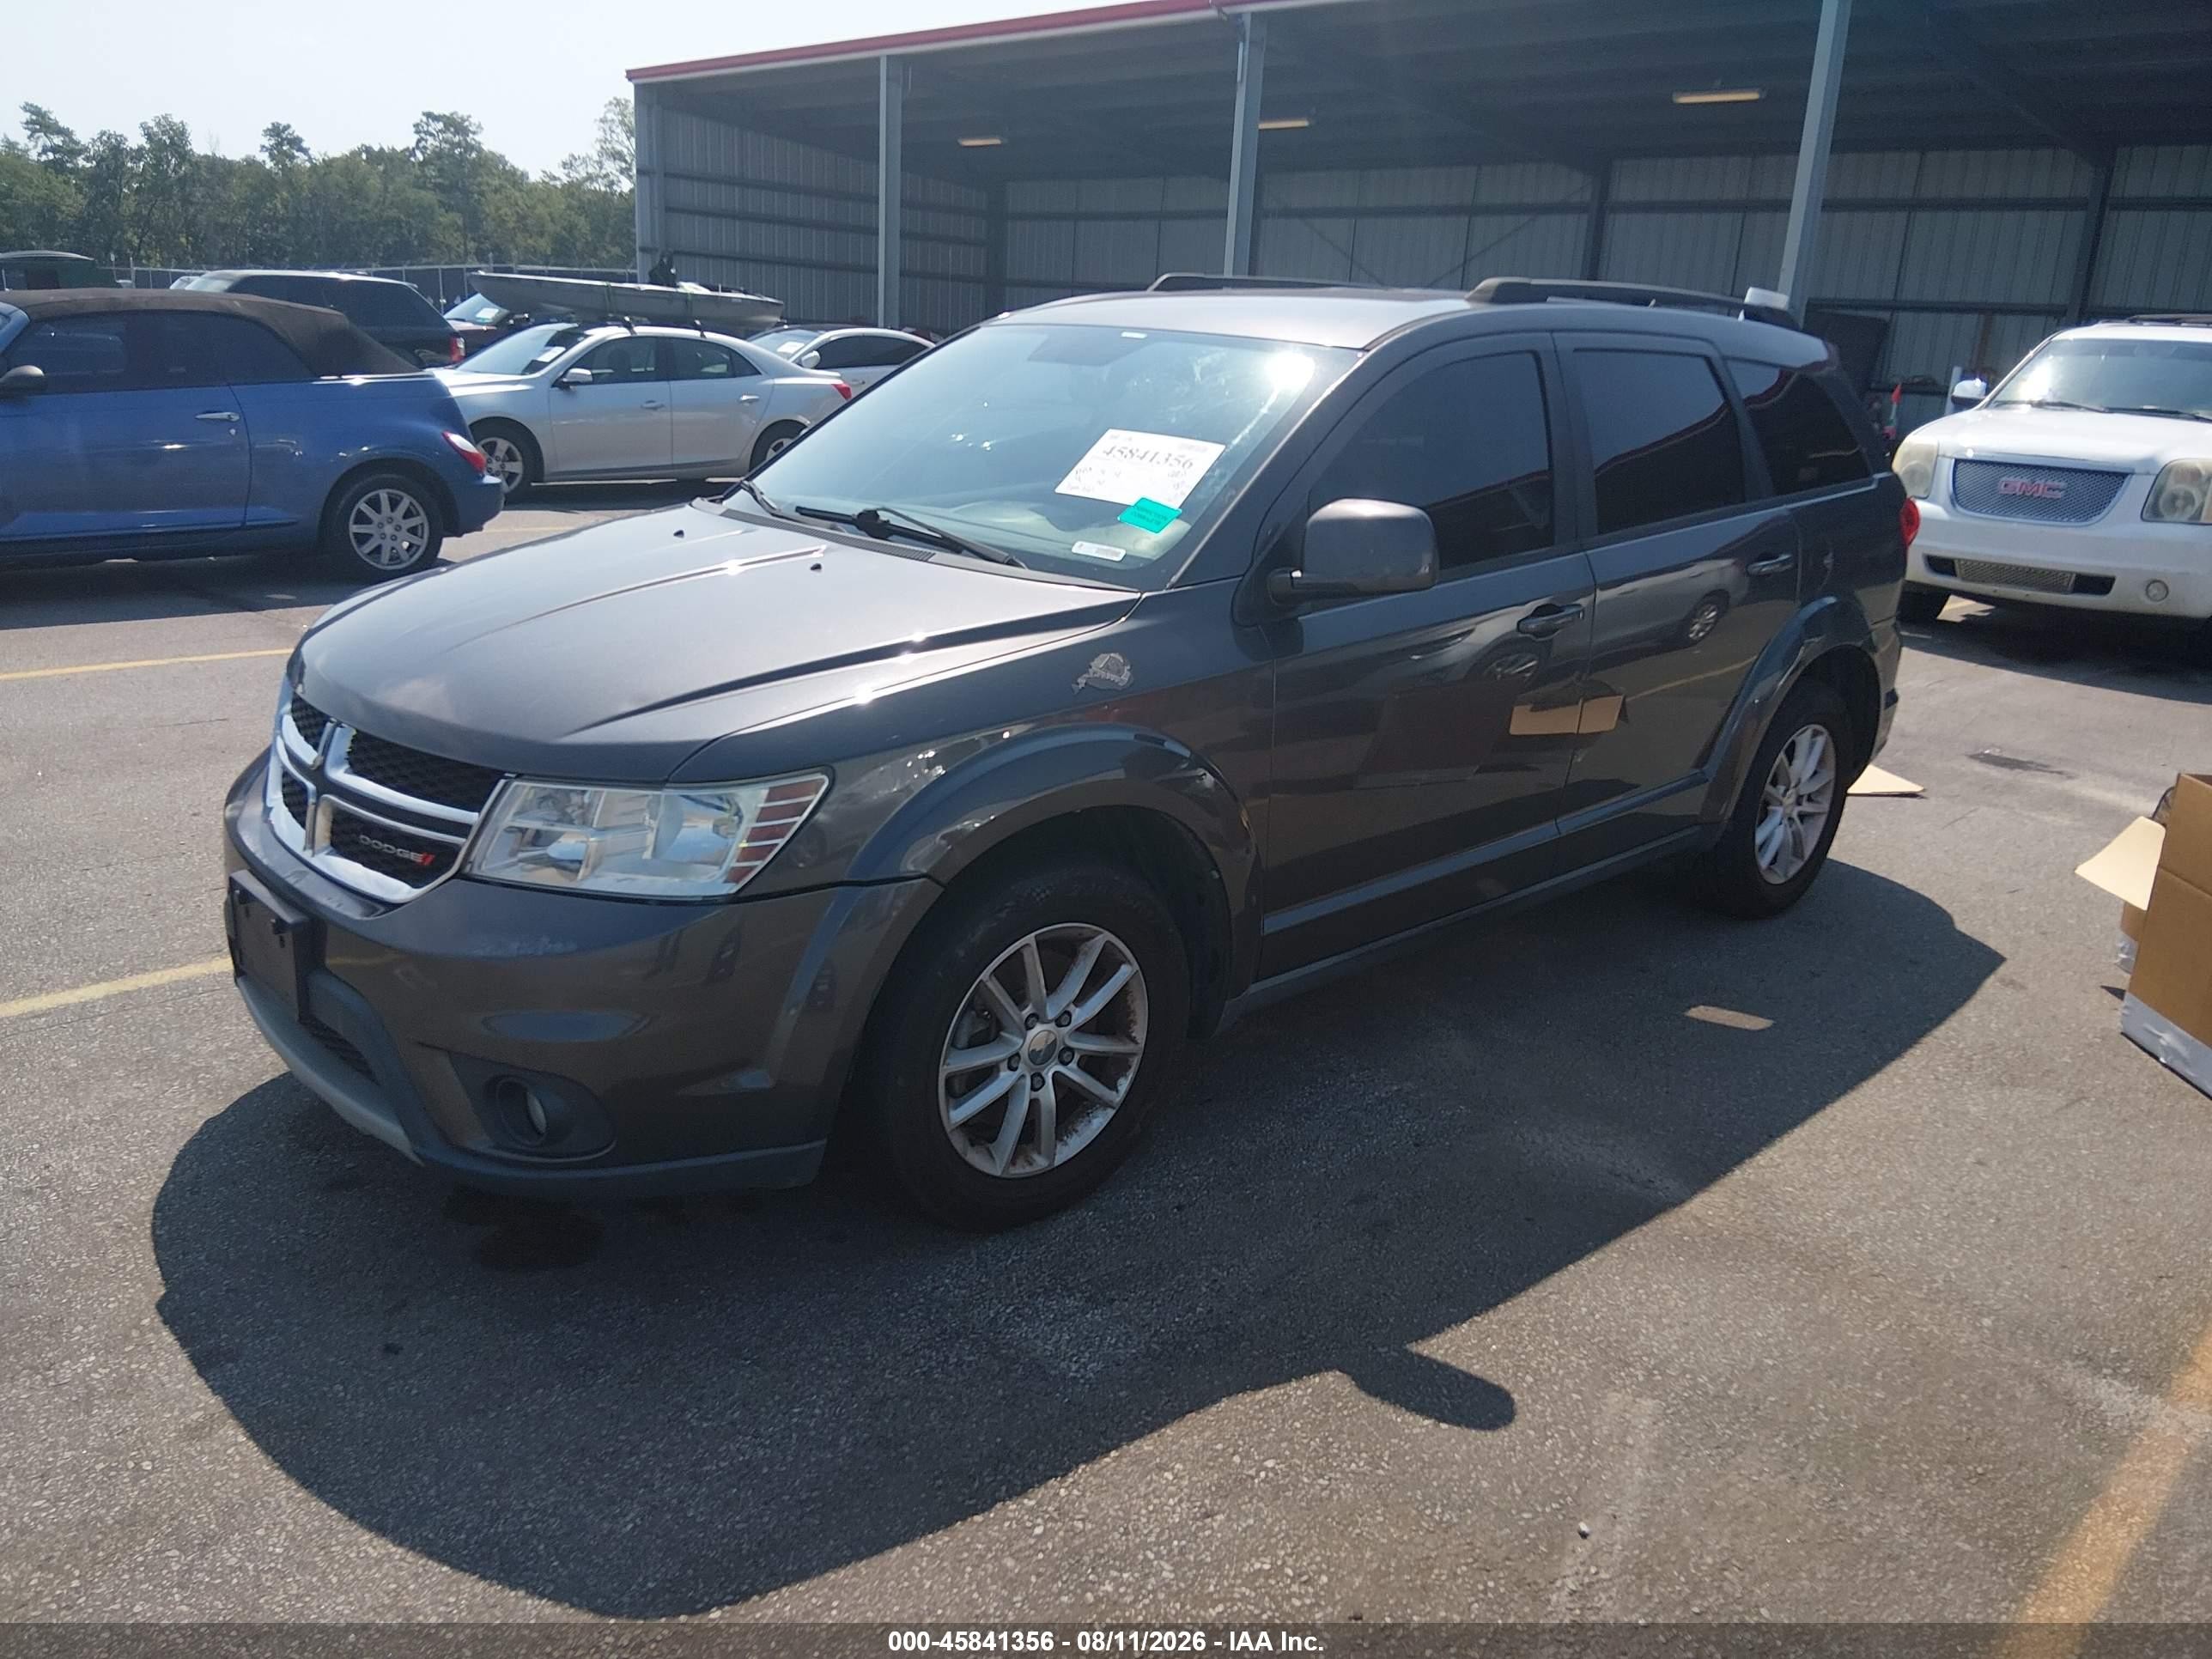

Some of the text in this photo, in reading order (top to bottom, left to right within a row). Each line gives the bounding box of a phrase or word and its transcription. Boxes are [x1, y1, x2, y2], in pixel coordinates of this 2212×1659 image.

[1103, 445, 1194, 470] 45841356
[1998, 477, 2065, 499] GMC
[359, 835, 424, 863] DODGE
